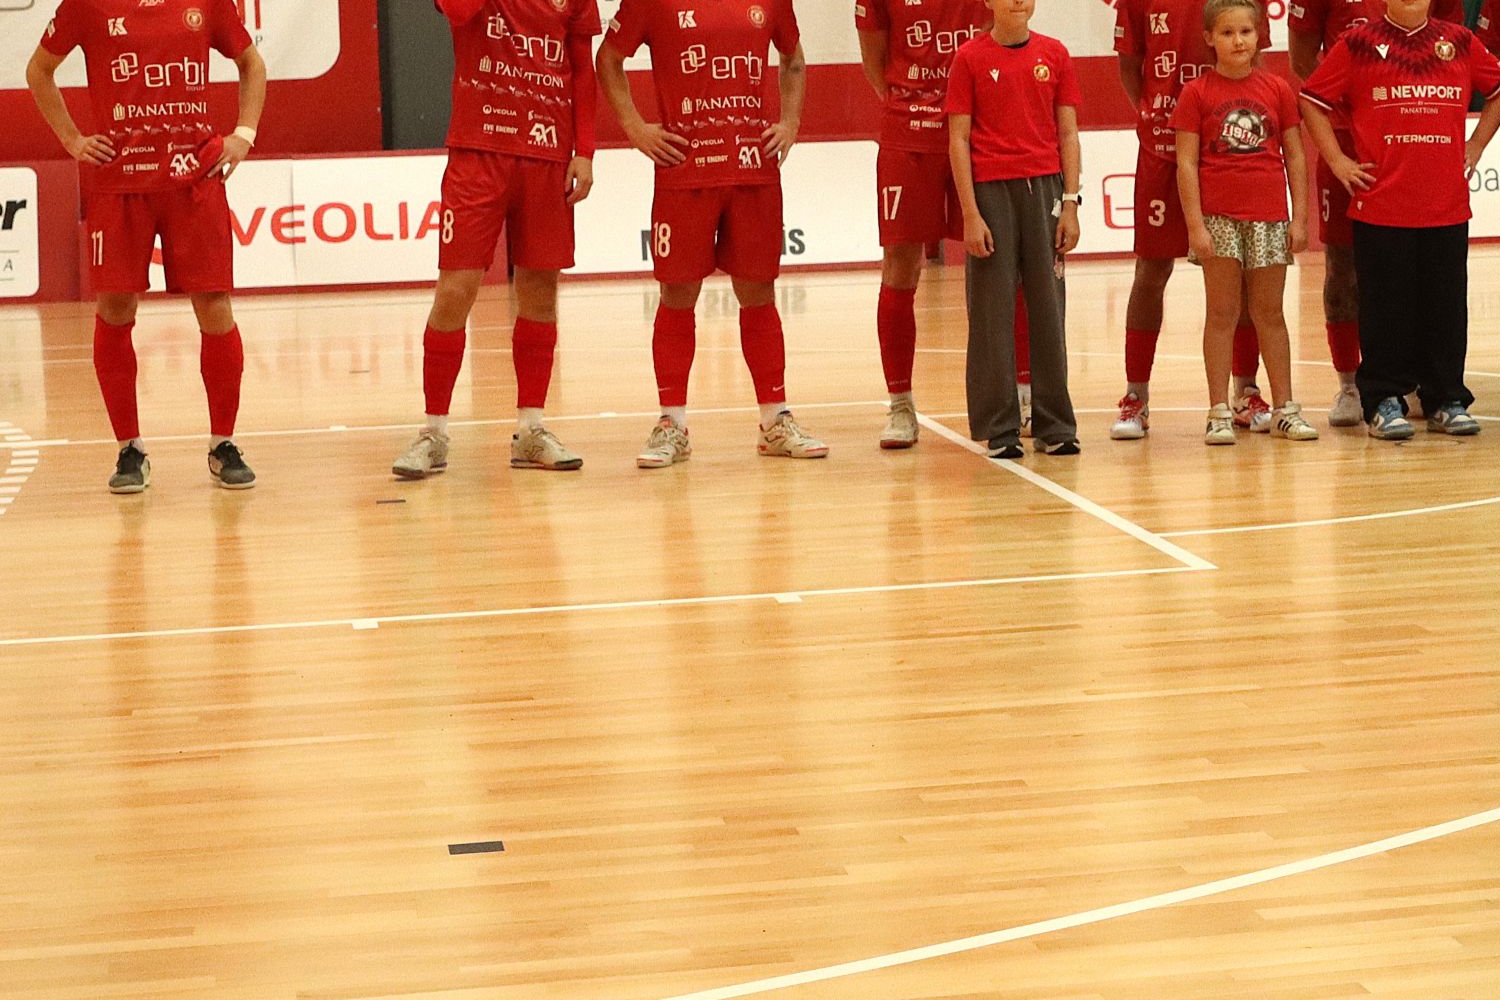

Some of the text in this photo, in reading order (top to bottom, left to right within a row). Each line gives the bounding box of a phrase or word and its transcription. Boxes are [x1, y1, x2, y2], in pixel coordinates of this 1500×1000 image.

[144, 56, 205, 88] erbi
[495, 61, 564, 89] PANATTONI
[696, 95, 762, 112] PANATTON
[1391, 85, 1462, 100] NEWPORT
[128, 102, 207, 119] PANATTONI
[1400, 106, 1439, 115] PANATTONI
[882, 186, 903, 221] 17
[1147, 199, 1166, 227] 3
[230, 201, 442, 247] VEOLIA
[441, 209, 454, 244] 8
[91, 230, 103, 267] 11
[653, 222, 671, 258] 18
